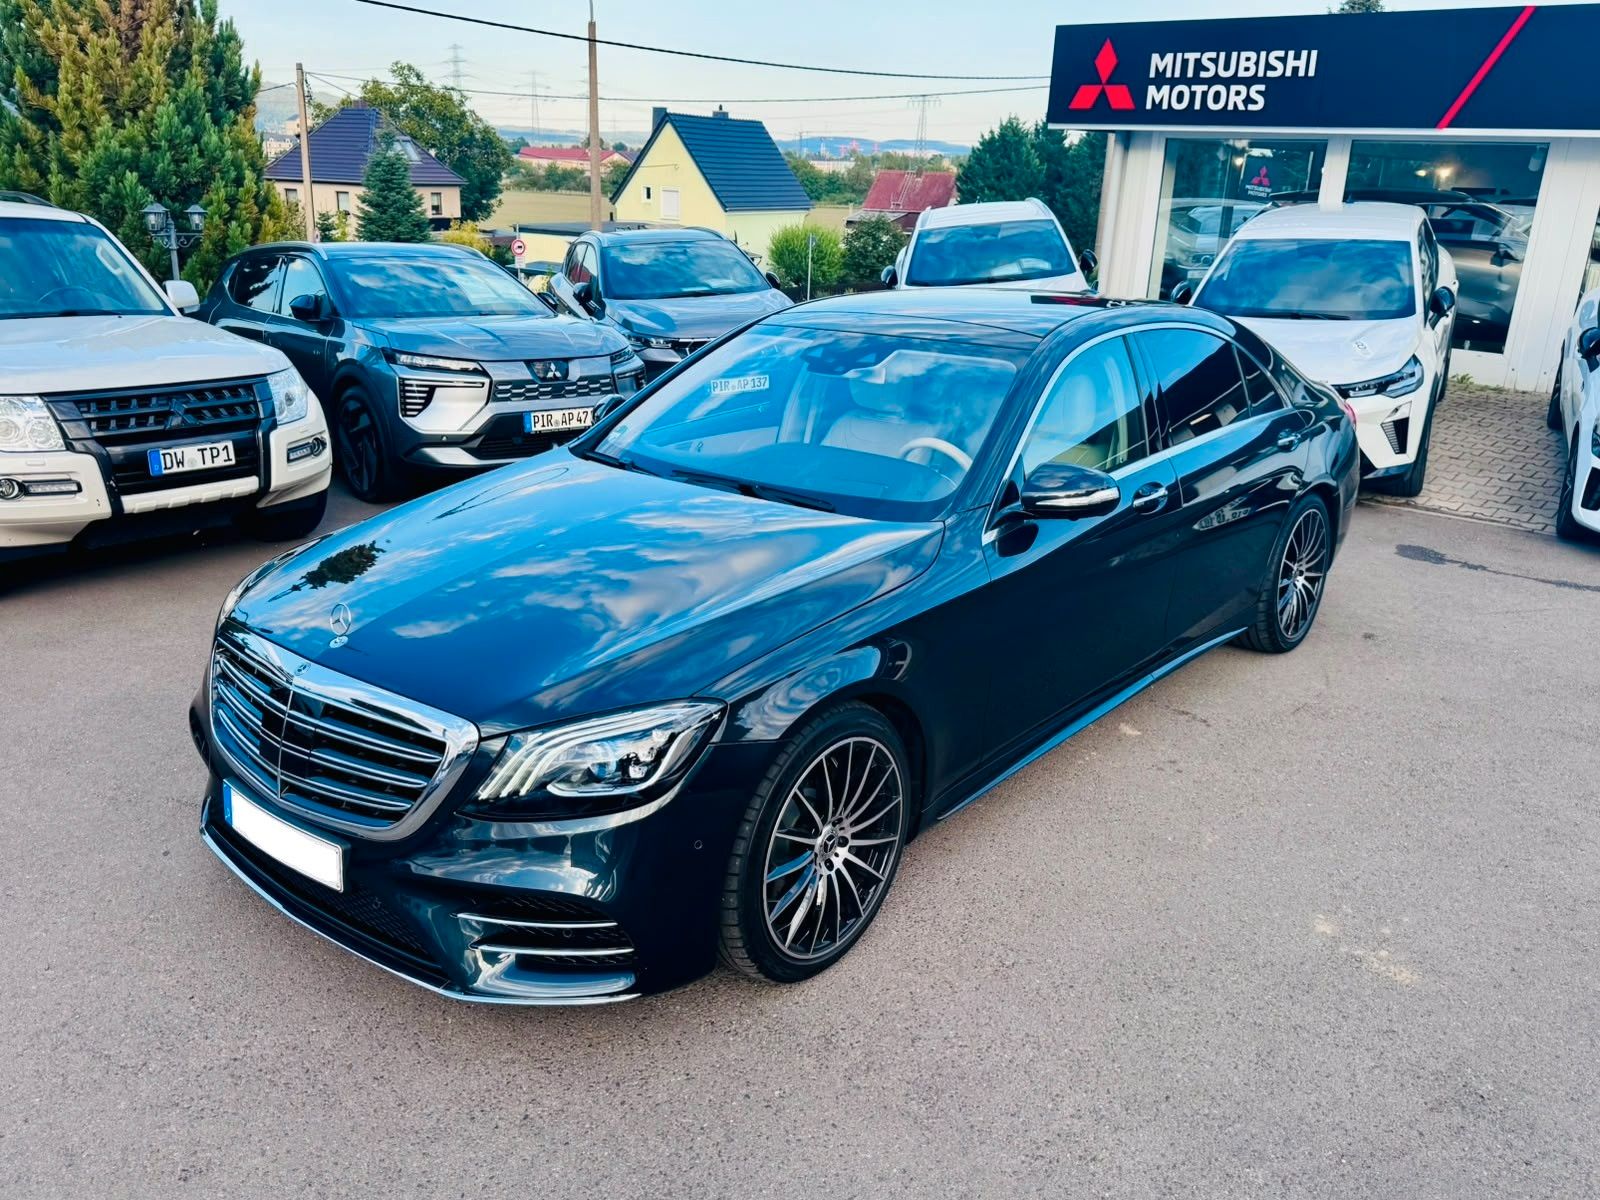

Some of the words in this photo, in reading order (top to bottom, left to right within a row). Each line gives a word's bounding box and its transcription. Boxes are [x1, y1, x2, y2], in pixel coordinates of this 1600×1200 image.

[1149, 50, 1318, 78] MITSUBISHI
[1146, 84, 1266, 111] MOTORS
[711, 380, 730, 392] PIR
[750, 376, 768, 389] 137
[532, 413, 554, 428] PIR
[561, 411, 575, 426] AP
[161, 450, 185, 471] DW
[197, 445, 233, 465] TP1
